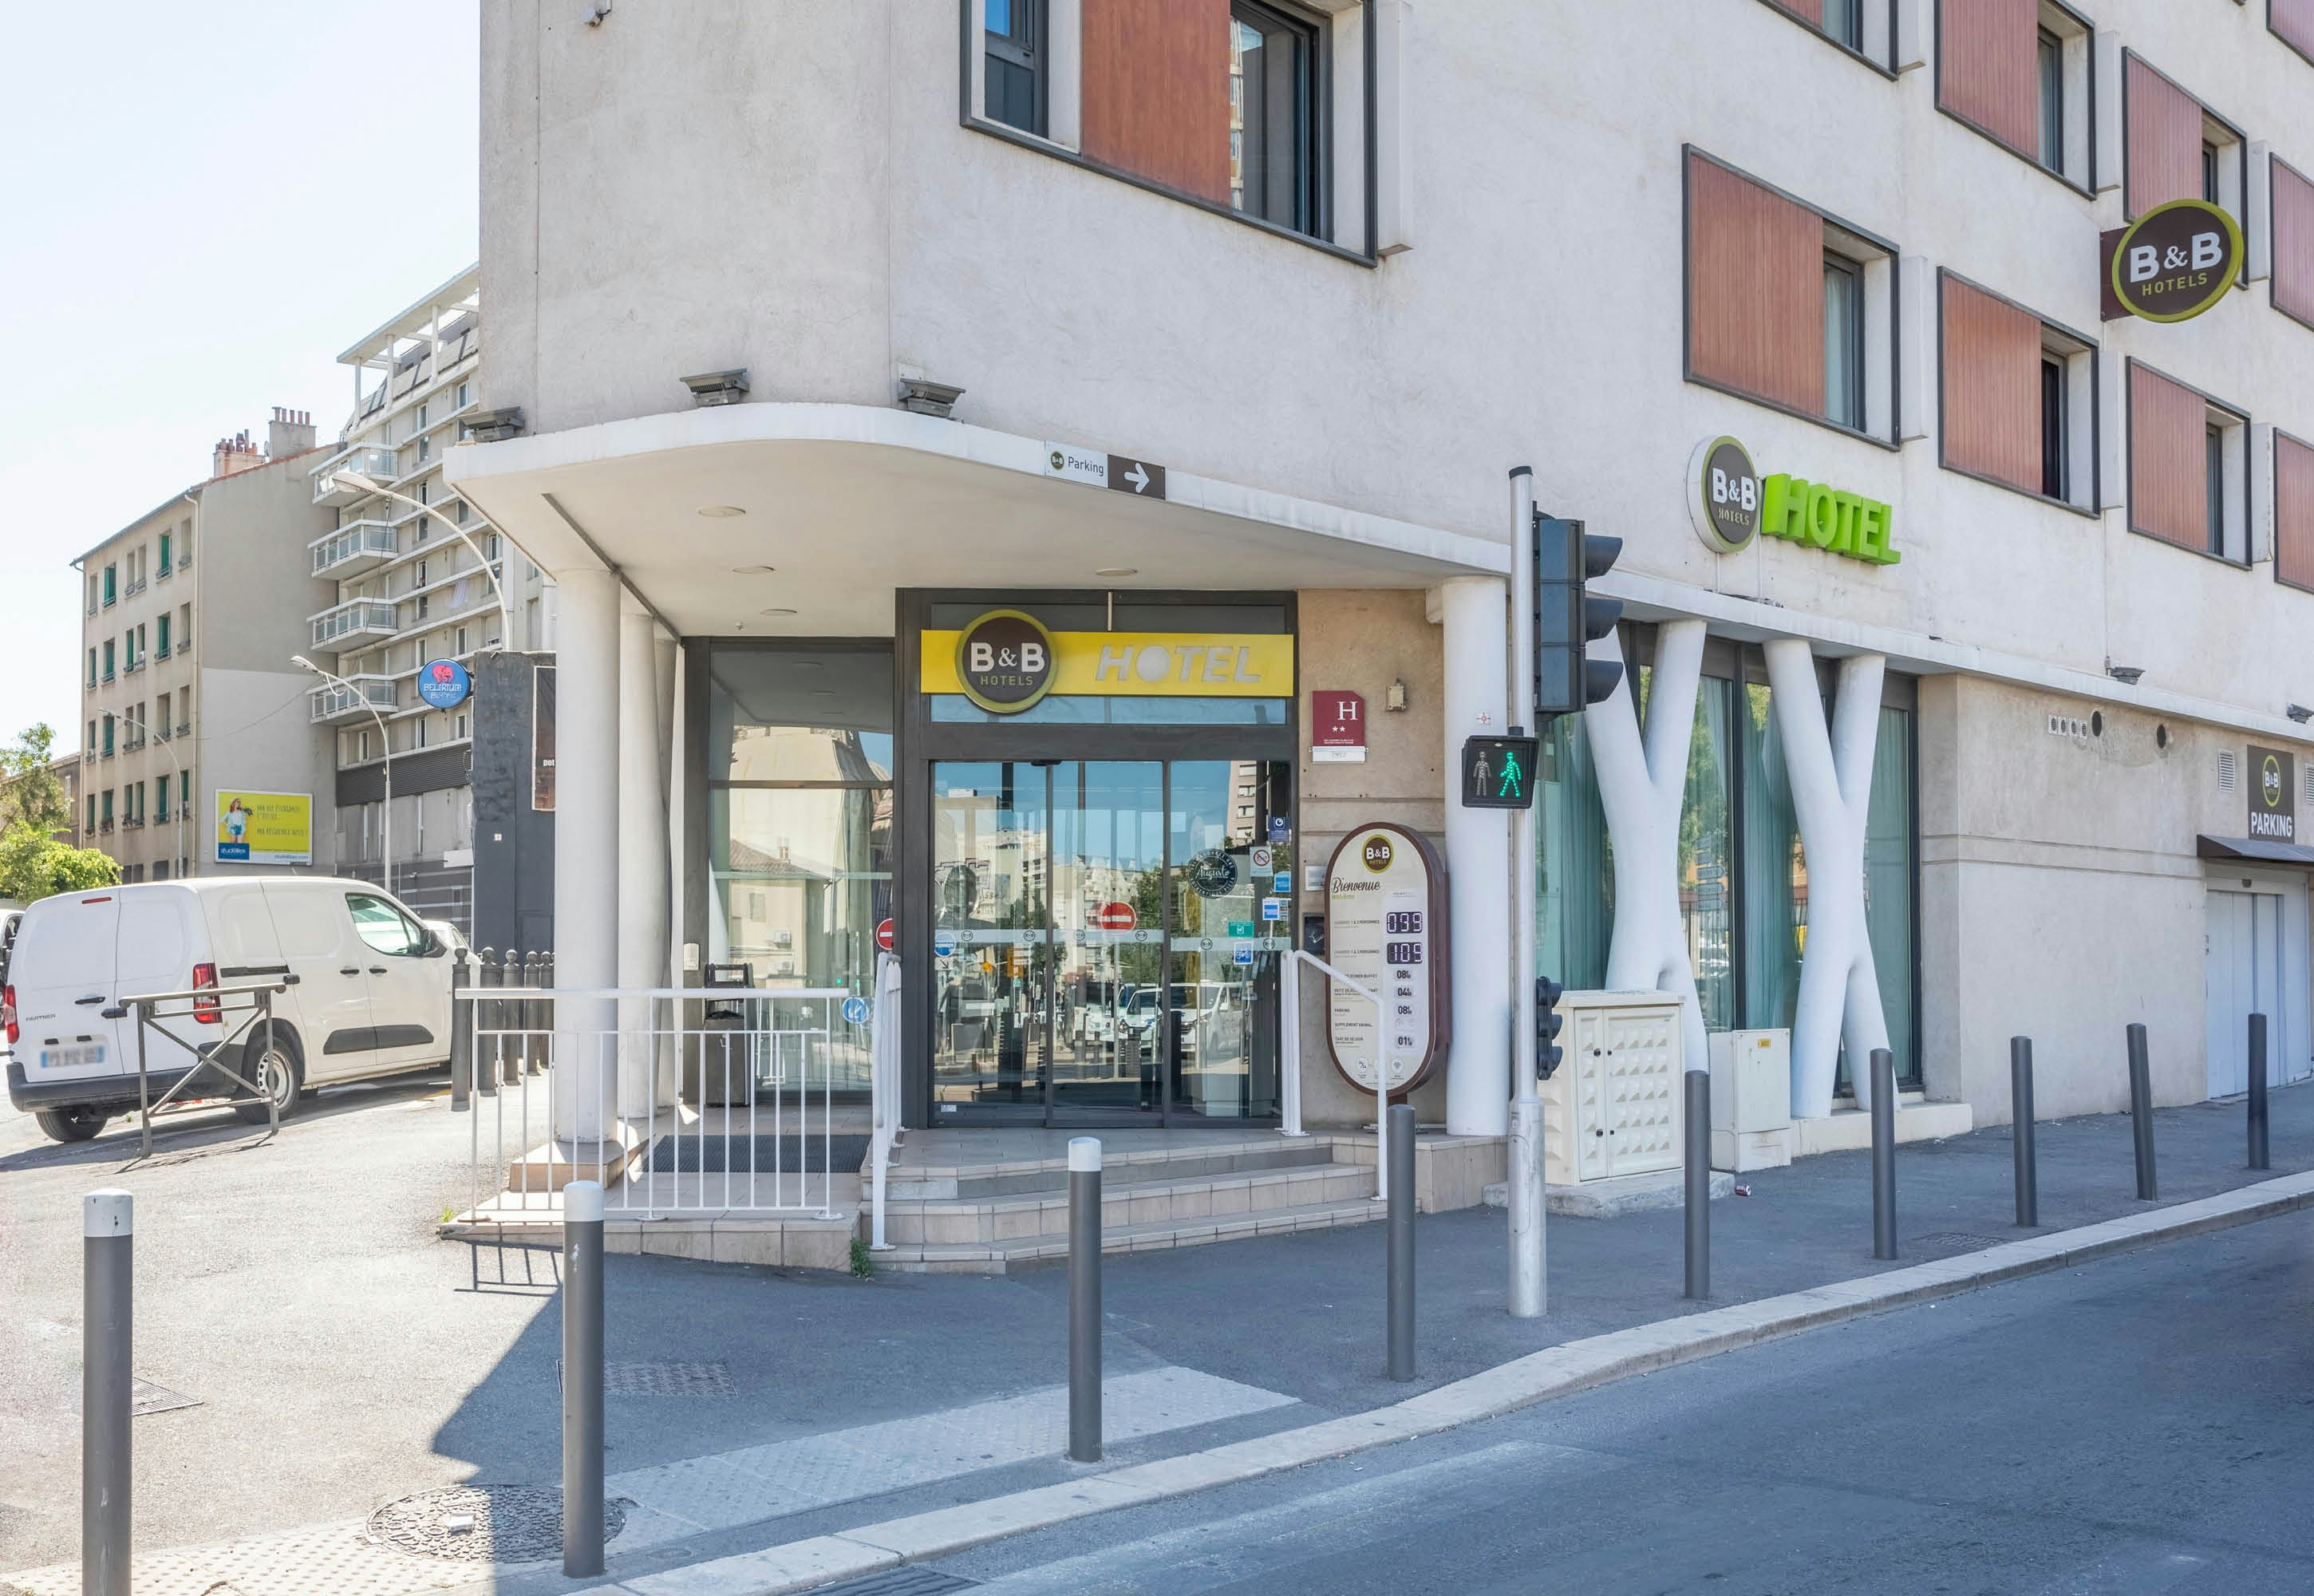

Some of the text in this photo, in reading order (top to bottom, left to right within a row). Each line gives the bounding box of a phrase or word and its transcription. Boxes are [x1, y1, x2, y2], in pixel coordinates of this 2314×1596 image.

[2130, 231, 2222, 283] B&B
[2142, 272, 2207, 296] HOTELS
[1052, 456, 1104, 477] B&B Parking
[1712, 468, 1756, 511] B&B
[1718, 507, 1750, 526] HOTELS
[1760, 473, 1901, 565] HOTEL
[970, 642, 1045, 673] B&B
[1095, 645, 1261, 684] HOTEL
[980, 675, 1034, 687] HOTELS
[1337, 701, 1358, 721] H
[2265, 771, 2279, 788] B&B
[2251, 812, 2292, 837] PARKING
[1366, 846, 1390, 859] B&B
[1195, 864, 1230, 880] Augusto
[1331, 877, 1380, 894] Bienvenue
[1388, 912, 1422, 933] 039
